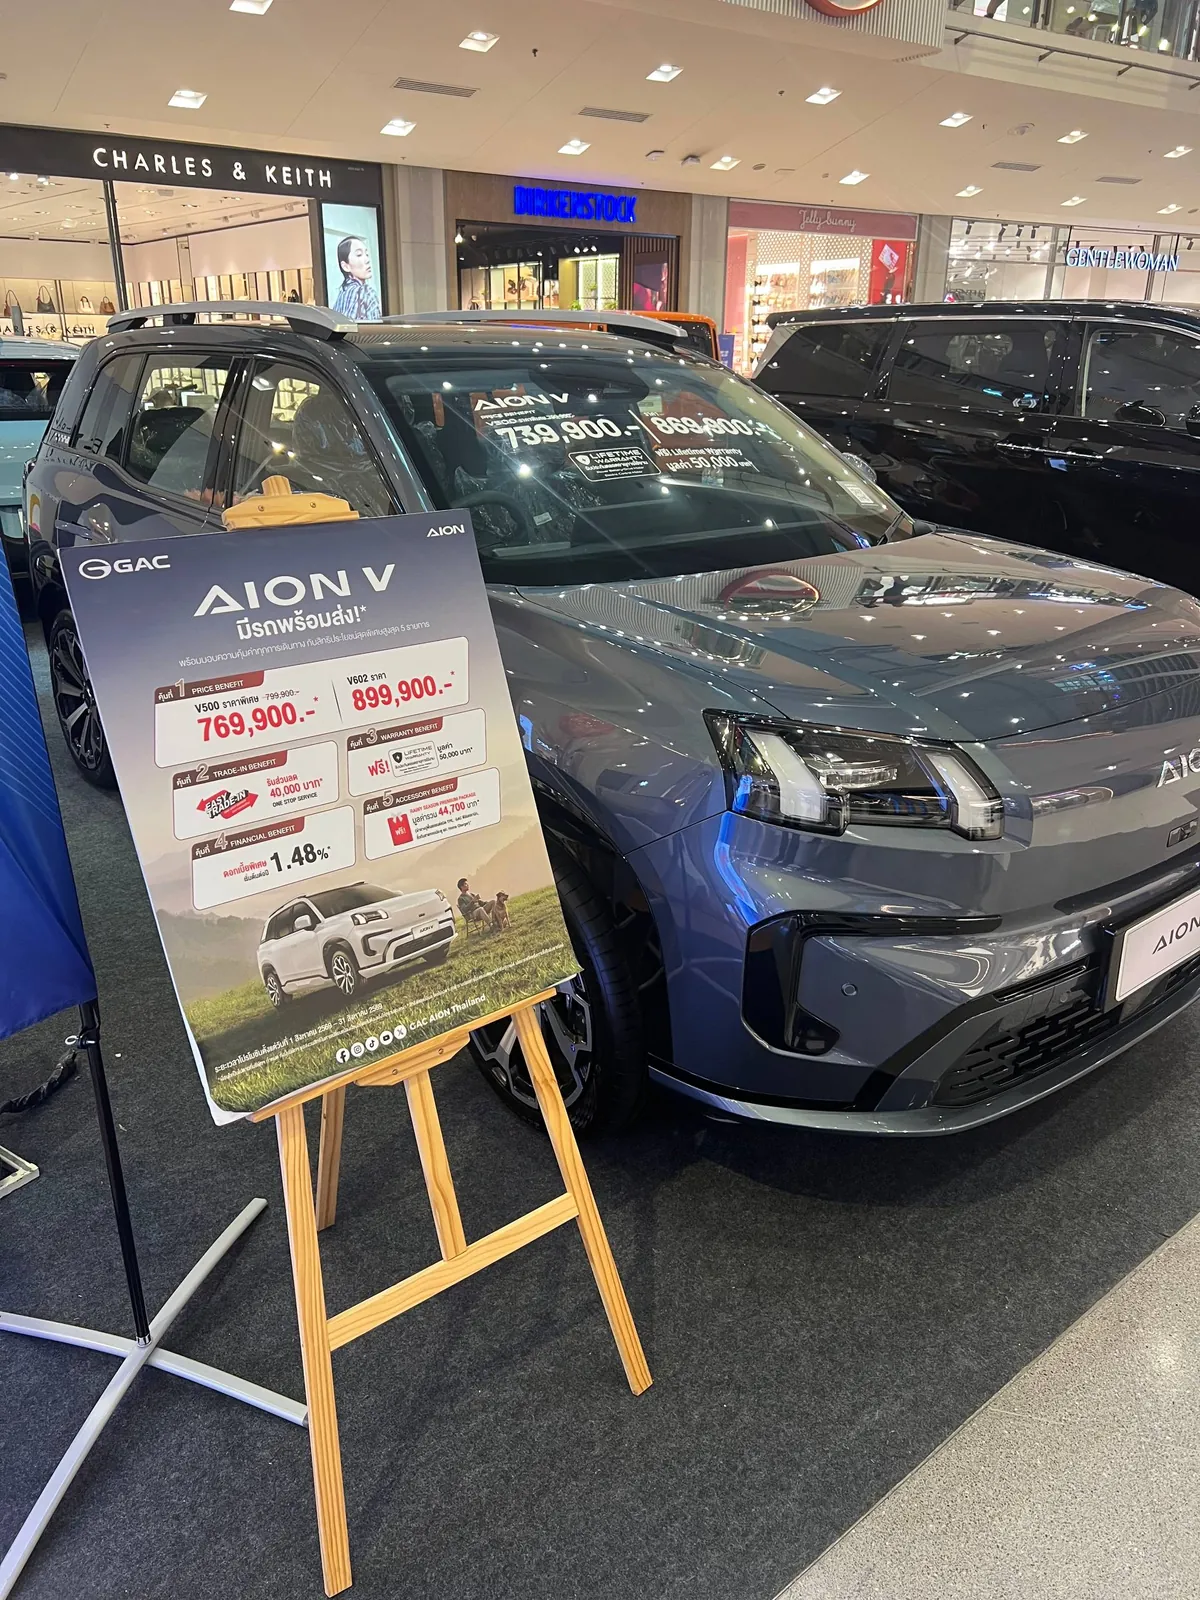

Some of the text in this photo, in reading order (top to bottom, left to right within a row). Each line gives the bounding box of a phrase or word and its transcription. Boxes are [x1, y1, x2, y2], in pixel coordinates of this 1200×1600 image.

[92, 147, 332, 188] CHARLES & KEITH
[514, 185, 637, 223] BIRKENSTOCK
[799, 209, 857, 233] Jelly bunny
[1065, 247, 1180, 272] GENTLEWOMAN
[474, 392, 569, 411] AION V
[495, 418, 641, 449] 739,900.-
[589, 449, 642, 459] LIFETIME
[594, 455, 645, 465] WARRANTY
[689, 456, 739, 470] 50,000
[426, 523, 465, 539] AION
[113, 554, 171, 574] GAC
[193, 563, 397, 617] AION V
[400, 624, 406, 632] 5
[406, 620, 430, 632] รายการ
[174, 677, 186, 698] 1
[192, 684, 214, 695] PRICE
[214, 679, 244, 691] BENEFIT
[347, 671, 387, 686] V602 ราคา
[195, 700, 220, 714] V500
[222, 693, 259, 710] ราคาพิเศษ
[365, 727, 378, 745] 3
[380, 729, 414, 741] WARRANTY
[414, 722, 438, 734] BENEFIT
[439, 750, 459, 761] 50,000
[195, 763, 210, 783] 2
[213, 764, 248, 778] TRADE-IN
[248, 758, 277, 771] BENEFIT
[368, 758, 390, 777] ฟรี!
[269, 782, 301, 799] 40,000
[272, 791, 318, 808] ONE STOP SERVICE
[382, 789, 394, 807] 5
[395, 789, 430, 804] ACCESSORY
[430, 783, 454, 796] BENEFIT
[206, 792, 230, 810] EASY
[438, 801, 466, 816] 44,700
[214, 832, 228, 850] 4
[230, 832, 267, 848] FINANCIAL
[267, 824, 296, 838] BENEFIT
[338, 1017, 346, 1026] 31
[409, 1017, 428, 1031] GAC
[429, 1007, 451, 1023] AION
[451, 994, 486, 1013] Thailand
